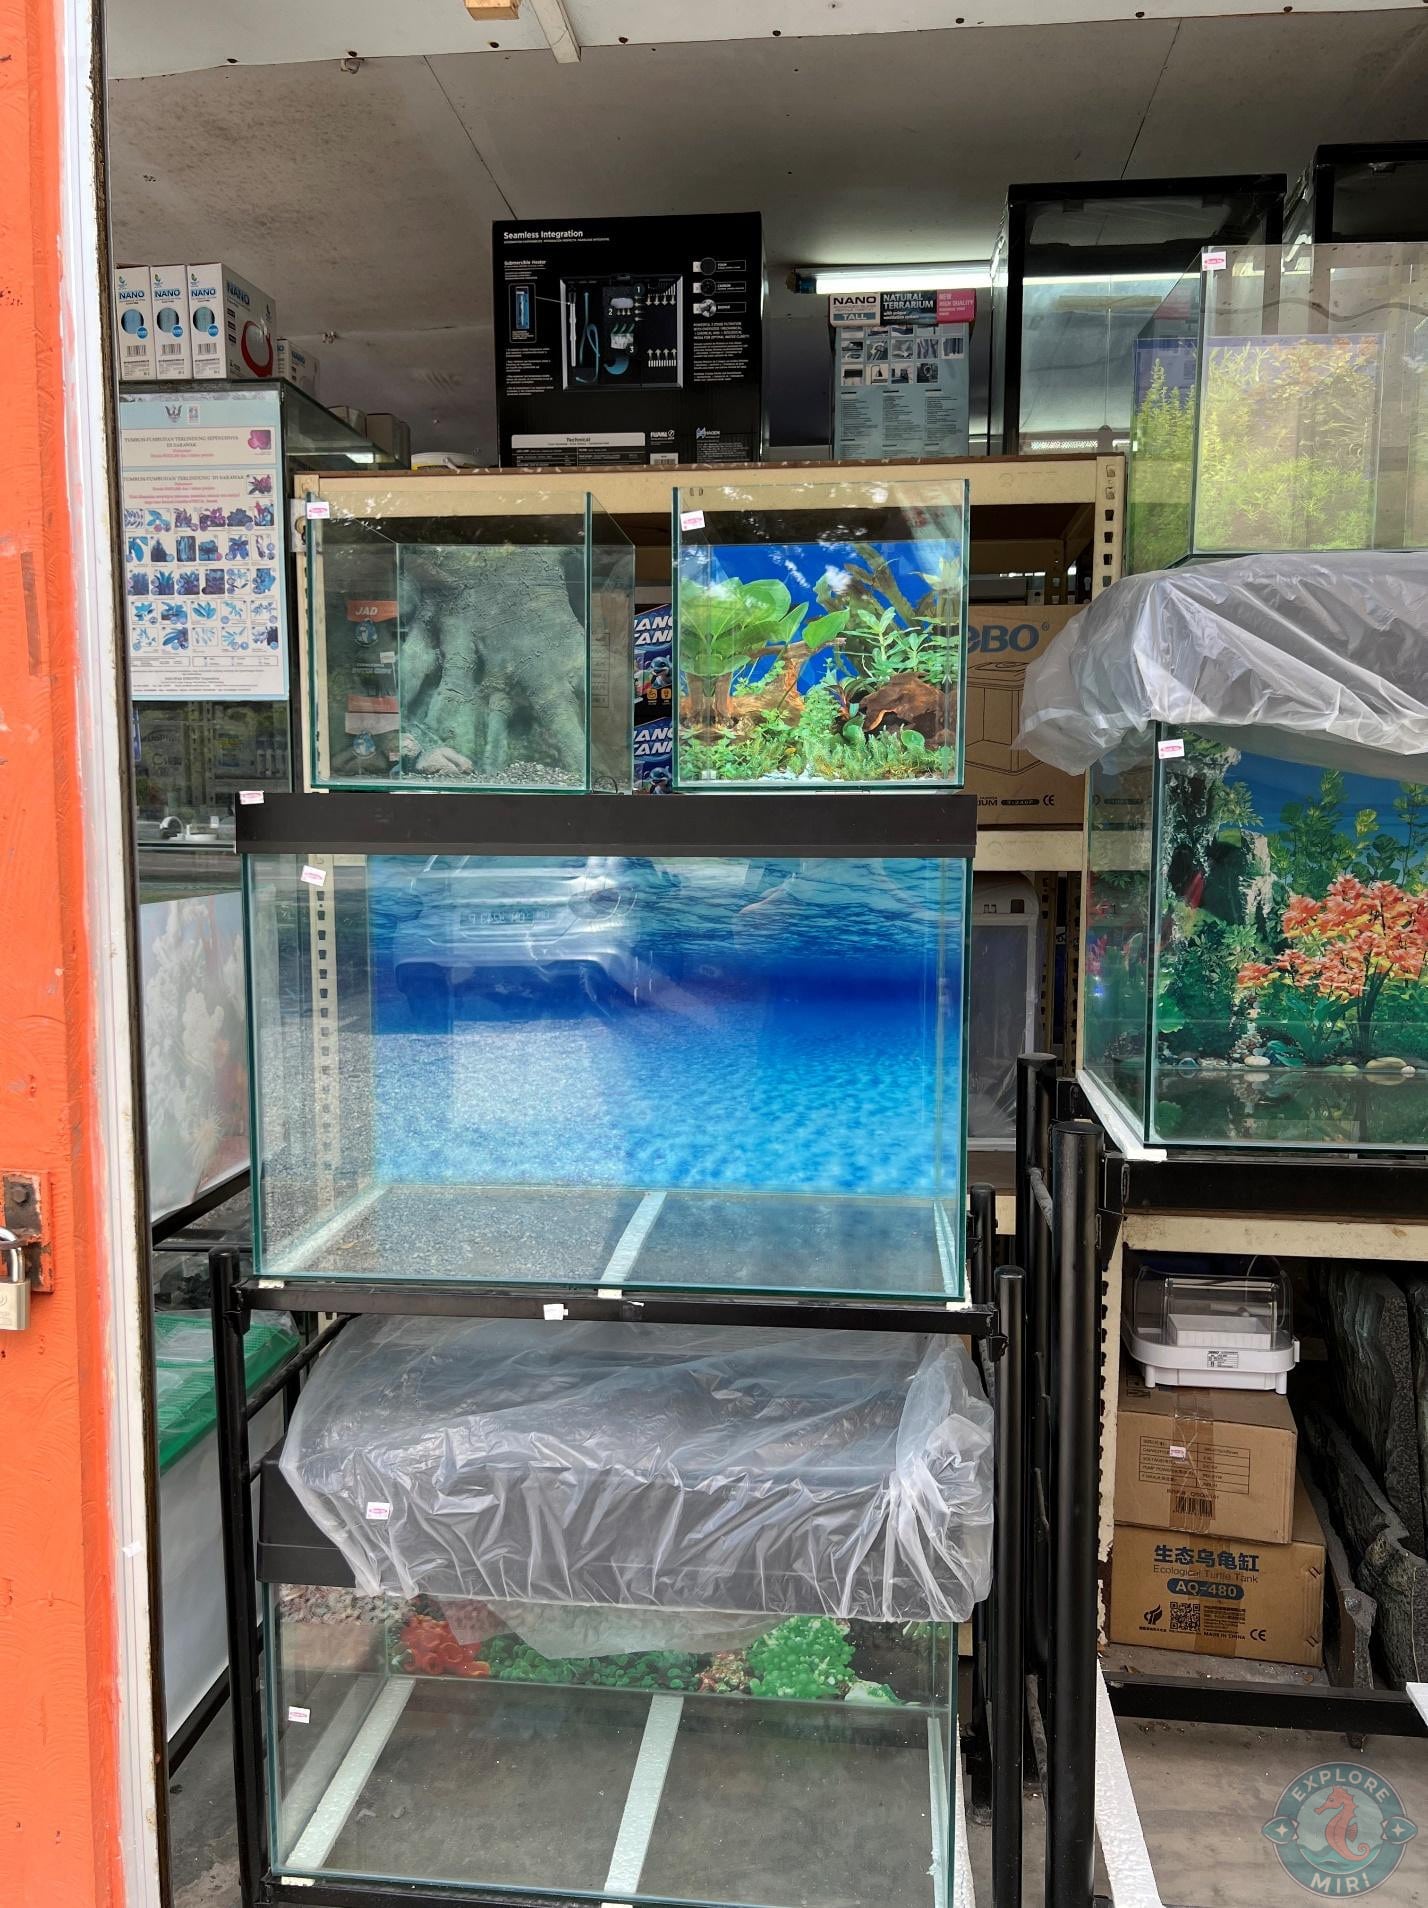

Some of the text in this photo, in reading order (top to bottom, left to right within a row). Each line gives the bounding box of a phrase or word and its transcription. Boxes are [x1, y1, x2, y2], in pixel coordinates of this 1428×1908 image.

[503, 229, 583, 240] Seamless Integration
[120, 290, 145, 299] NANO
[155, 289, 181, 298] NANO
[191, 288, 216, 297] NANO
[226, 281, 250, 305] NANO
[833, 296, 877, 305] NANO
[883, 293, 923, 302] NATURAL
[883, 300, 934, 310] TERRARIUM
[608, 308, 613, 316] 2
[842, 313, 867, 321] TALL
[355, 606, 378, 616] JAD
[1153, 1544, 1259, 1572] 生态乌龟缸
[1153, 1564, 1258, 1583] Ecological Turtle Tank
[1175, 1580, 1237, 1597] AQ-480
[1204, 1631, 1219, 1639] MADE
